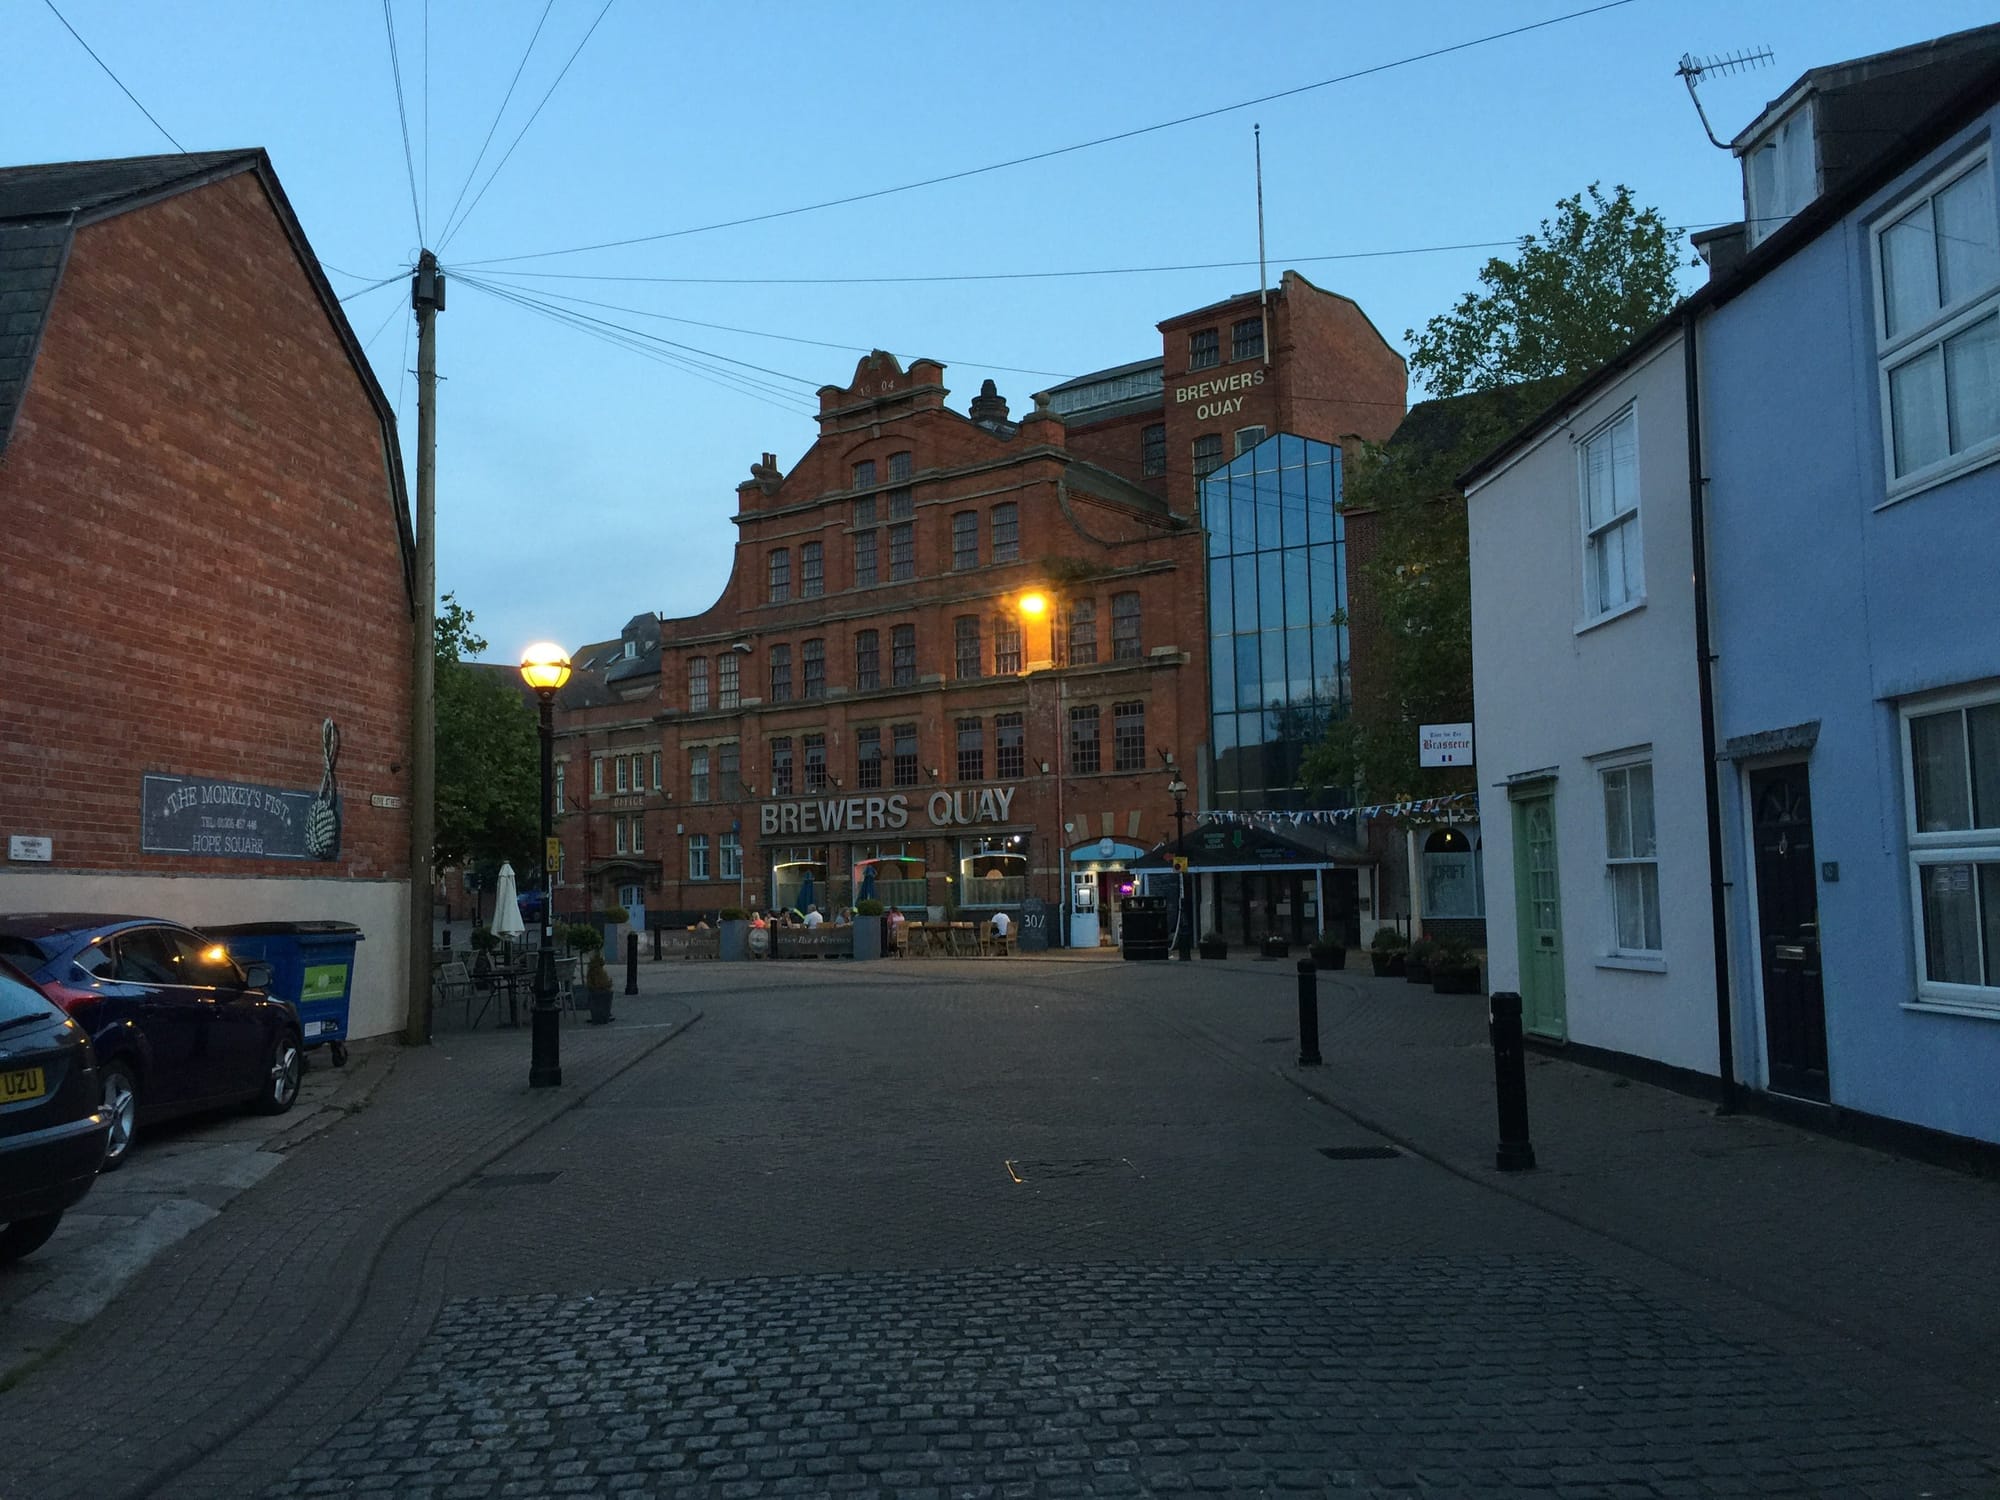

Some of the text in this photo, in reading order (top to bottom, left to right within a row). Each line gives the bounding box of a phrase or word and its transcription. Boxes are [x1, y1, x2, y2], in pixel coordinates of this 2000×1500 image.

[1175, 369, 1265, 403] BREWERS
[1196, 396, 1244, 421] QUAY
[1423, 739, 1470, 751] Brasserie
[167, 785, 291, 821] THE MONKEY'S FIST
[760, 786, 1017, 836] BREWERS QUAY
[192, 834, 264, 856] HOPE SQUARE
[4, 1070, 38, 1096] UZU
